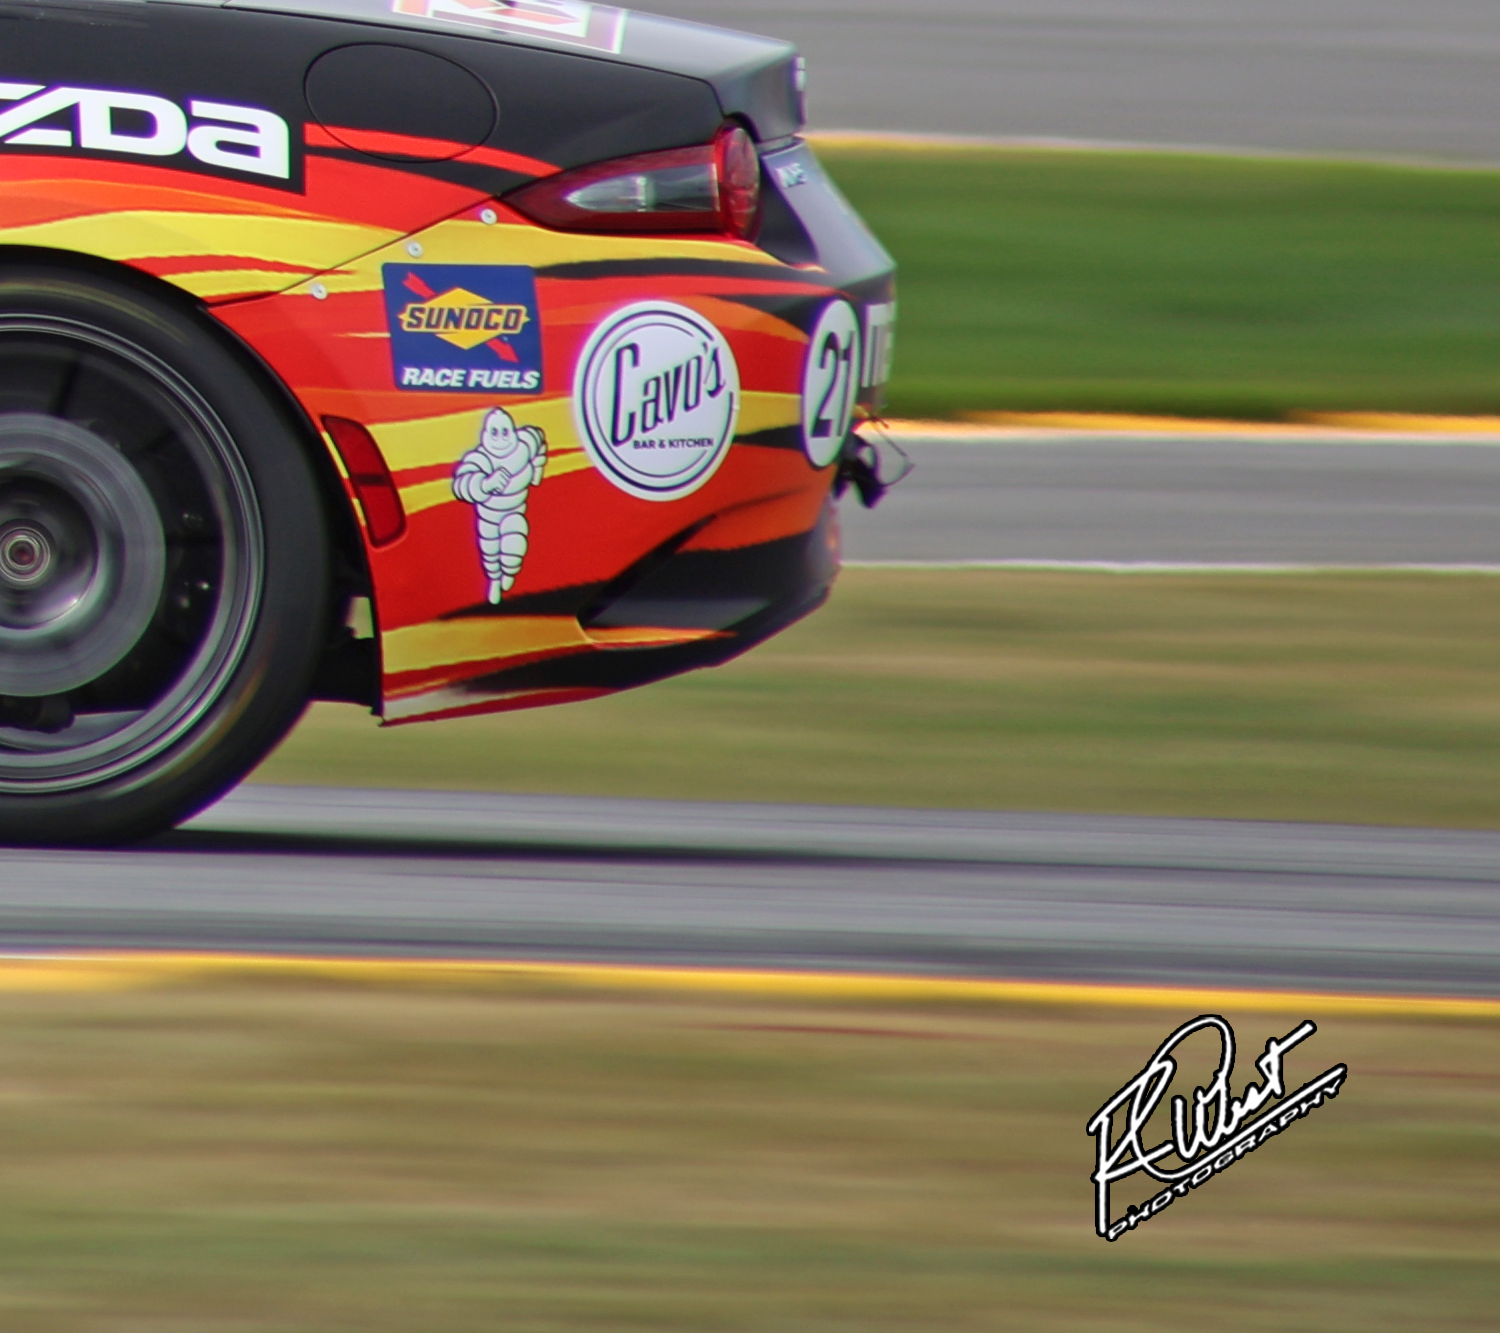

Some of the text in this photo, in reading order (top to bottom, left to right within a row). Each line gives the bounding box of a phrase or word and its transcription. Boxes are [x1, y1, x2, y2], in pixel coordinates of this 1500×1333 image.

[406, 306, 522, 330] SUNOCO
[402, 367, 540, 389] RACE FUELS
[810, 332, 856, 438] 21
[610, 341, 726, 447] Cavo's
[632, 439, 657, 450] BAR
[668, 438, 714, 448] KITCHEN
